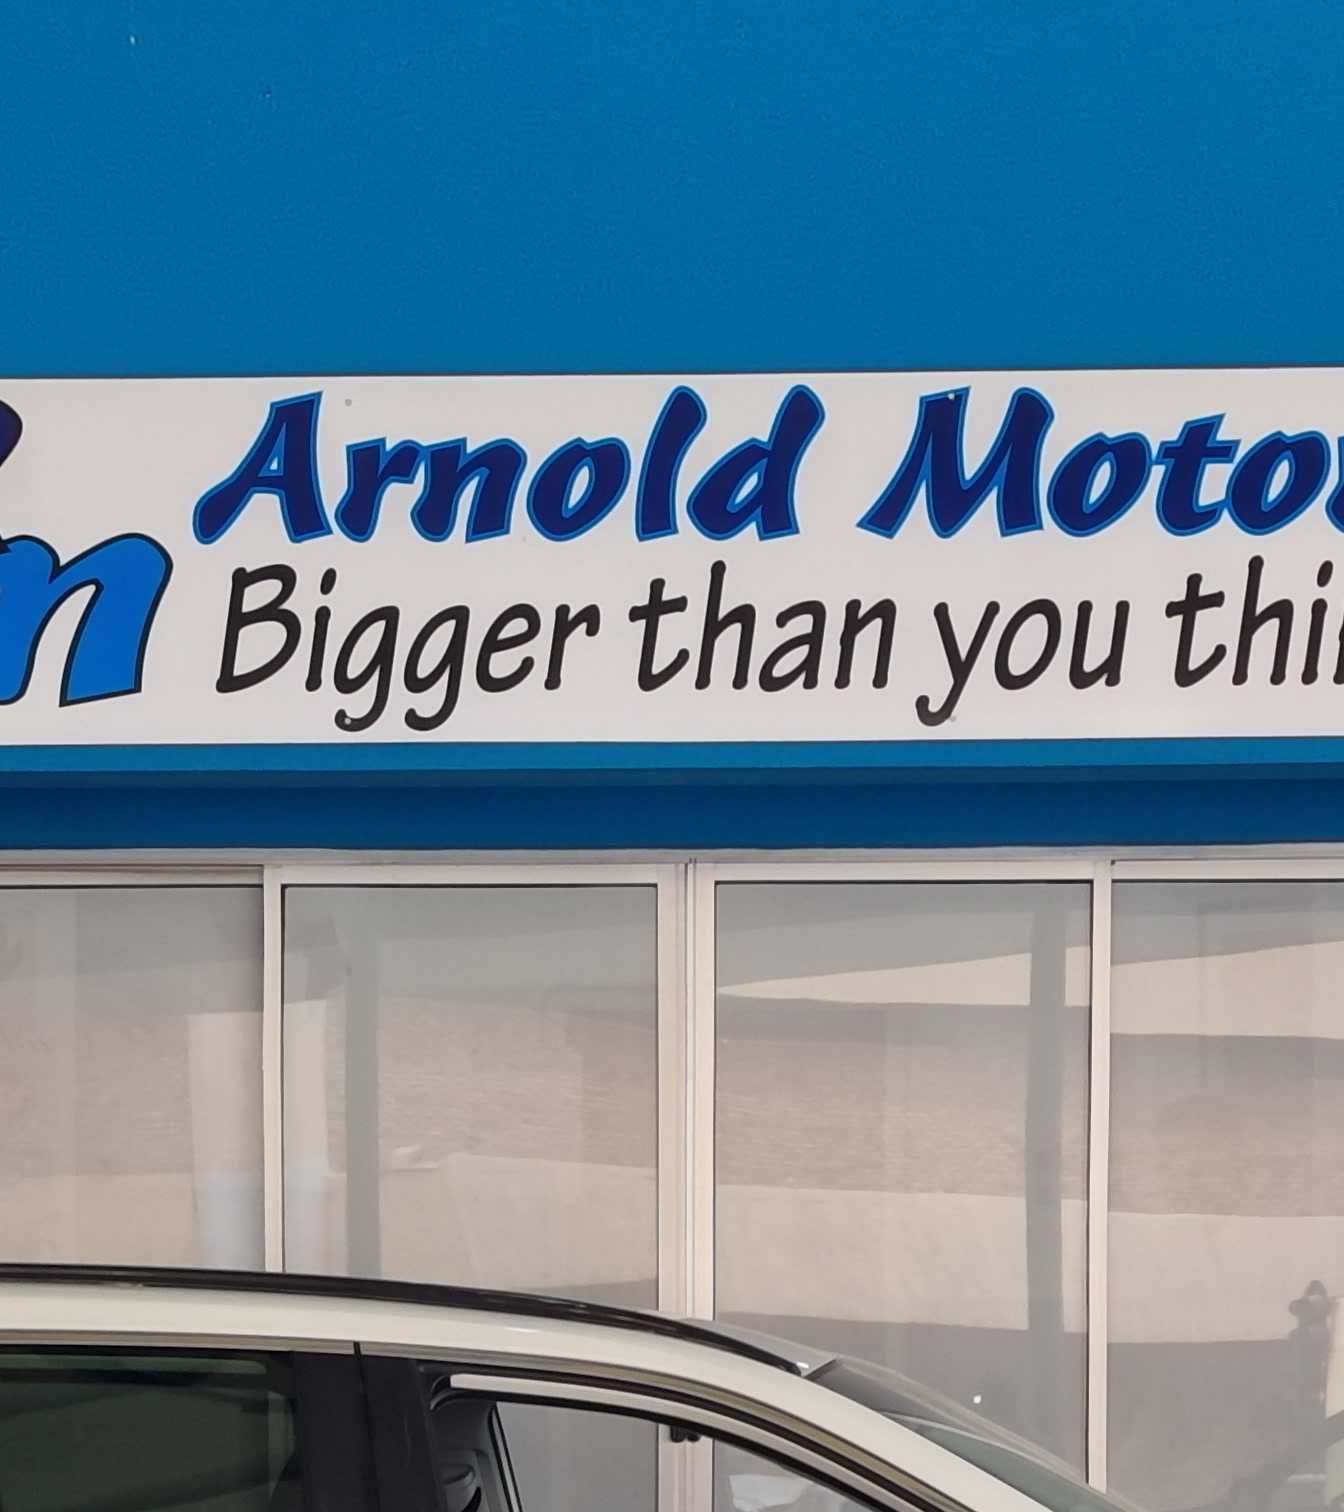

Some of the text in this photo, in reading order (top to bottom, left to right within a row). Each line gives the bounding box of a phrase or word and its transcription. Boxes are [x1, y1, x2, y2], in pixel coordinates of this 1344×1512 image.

[192, 383, 827, 544] Arnold
[216, 563, 603, 733] Bigger
[629, 559, 899, 694] than
[913, 596, 1133, 728] you
